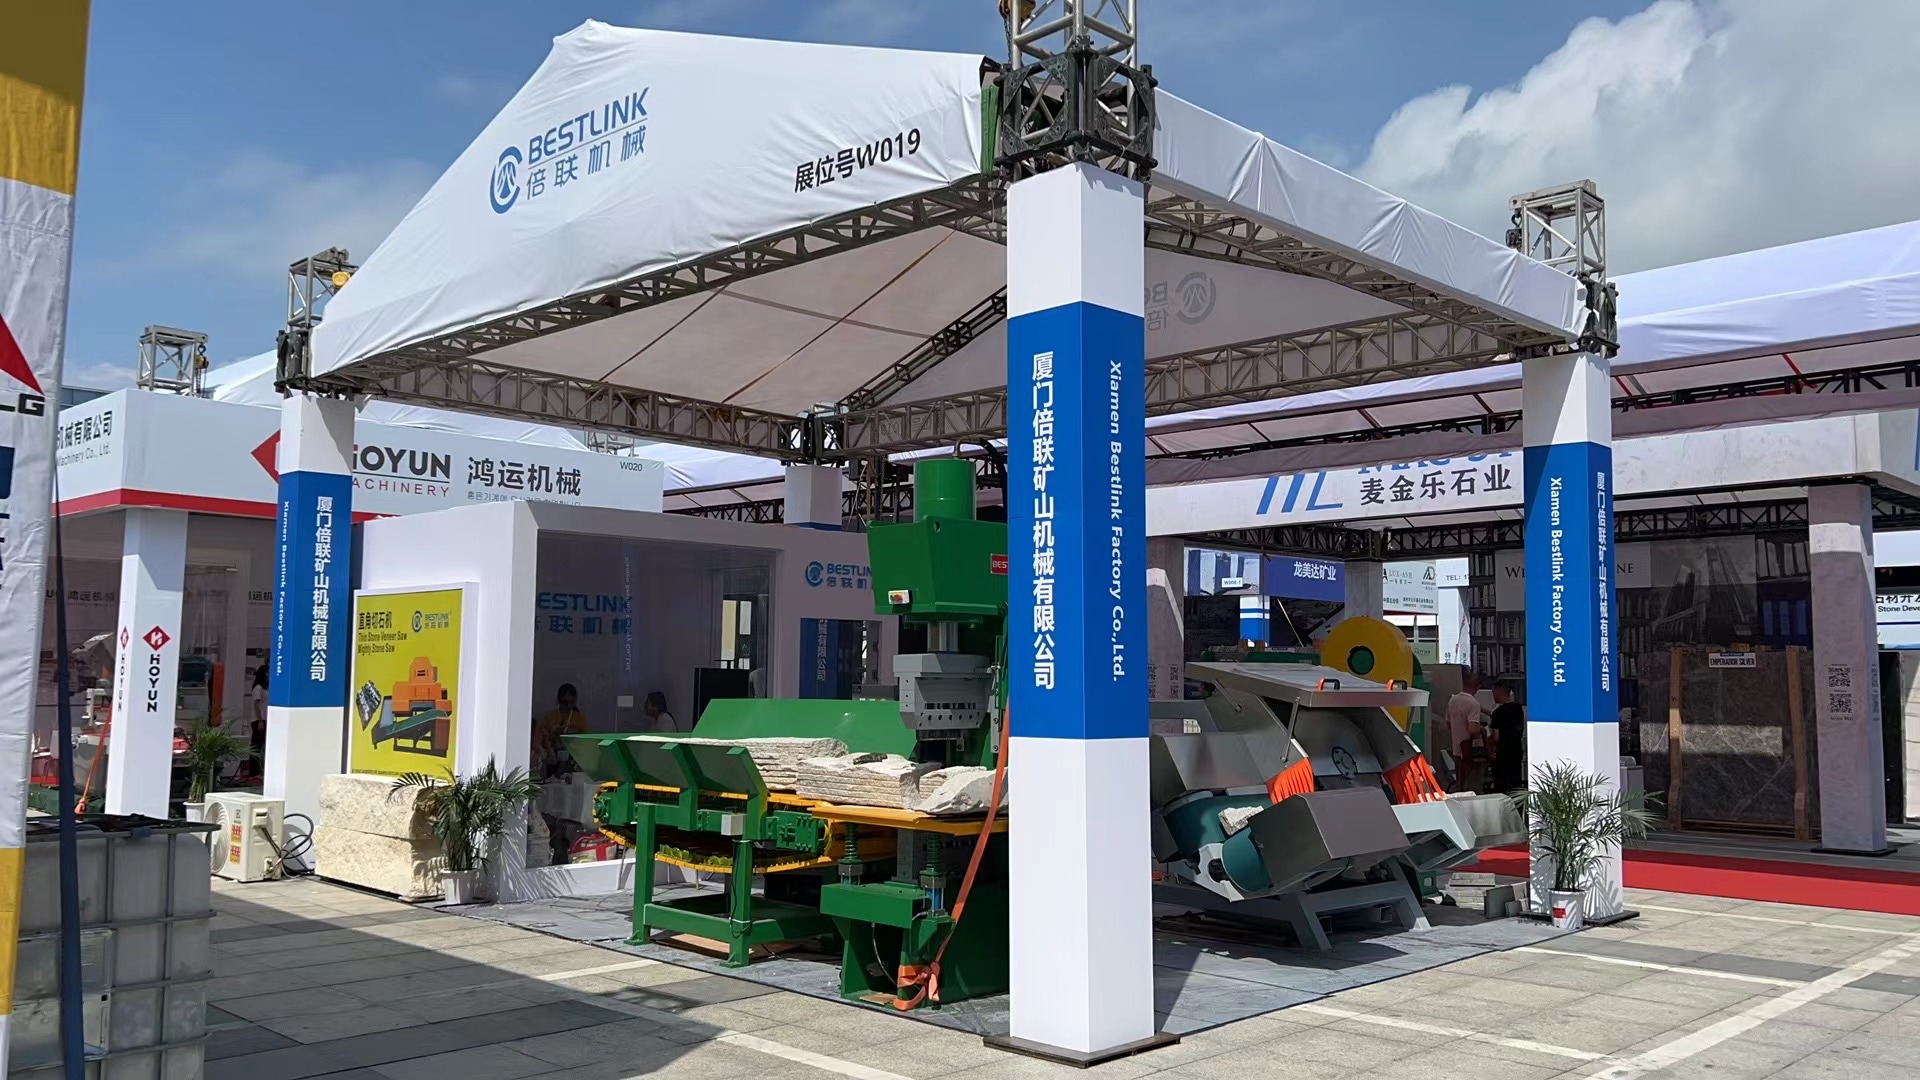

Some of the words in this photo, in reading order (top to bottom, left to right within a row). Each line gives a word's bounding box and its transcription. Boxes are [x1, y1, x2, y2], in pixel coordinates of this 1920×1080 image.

[528, 87, 649, 165] BESTLINK
[526, 125, 647, 200] 倍联机械
[795, 128, 921, 193] 展位号W019
[1110, 360, 1122, 434] Xiamen
[352, 477, 449, 497] ACHINERY
[467, 456, 581, 497] 鸿运机械
[619, 461, 643, 471] W020
[1110, 443, 1123, 520] Bestlink
[1360, 464, 1512, 505] 麦金乐石业
[1032, 351, 1055, 690] 厦门倍联矿山机械有限公司
[1550, 477, 1562, 526] Xiamen
[280, 545, 288, 587] Bestlink
[827, 563, 873, 576] BESTLIN
[1109, 526, 1123, 600] Factory
[1293, 561, 1337, 580] 龙美达矿业
[1551, 529, 1564, 581] Bestlink
[278, 591, 286, 632] Factory
[310, 496, 333, 682] 厦门倍联矿山机械有限公司
[536, 592, 632, 612] ESTLINK
[1550, 585, 1564, 634] Factory
[359, 611, 392, 630] 直角切石机
[368, 632, 380, 641] Stone
[381, 631, 397, 641] Veneer
[397, 630, 408, 640] Saw
[1111, 605, 1125, 682] Co.,Ltd.
[372, 643, 385, 653] Stone
[385, 643, 395, 653] Saw
[1552, 636, 1565, 687] Co.,Ltd.
[147, 653, 161, 713] HOYUN
